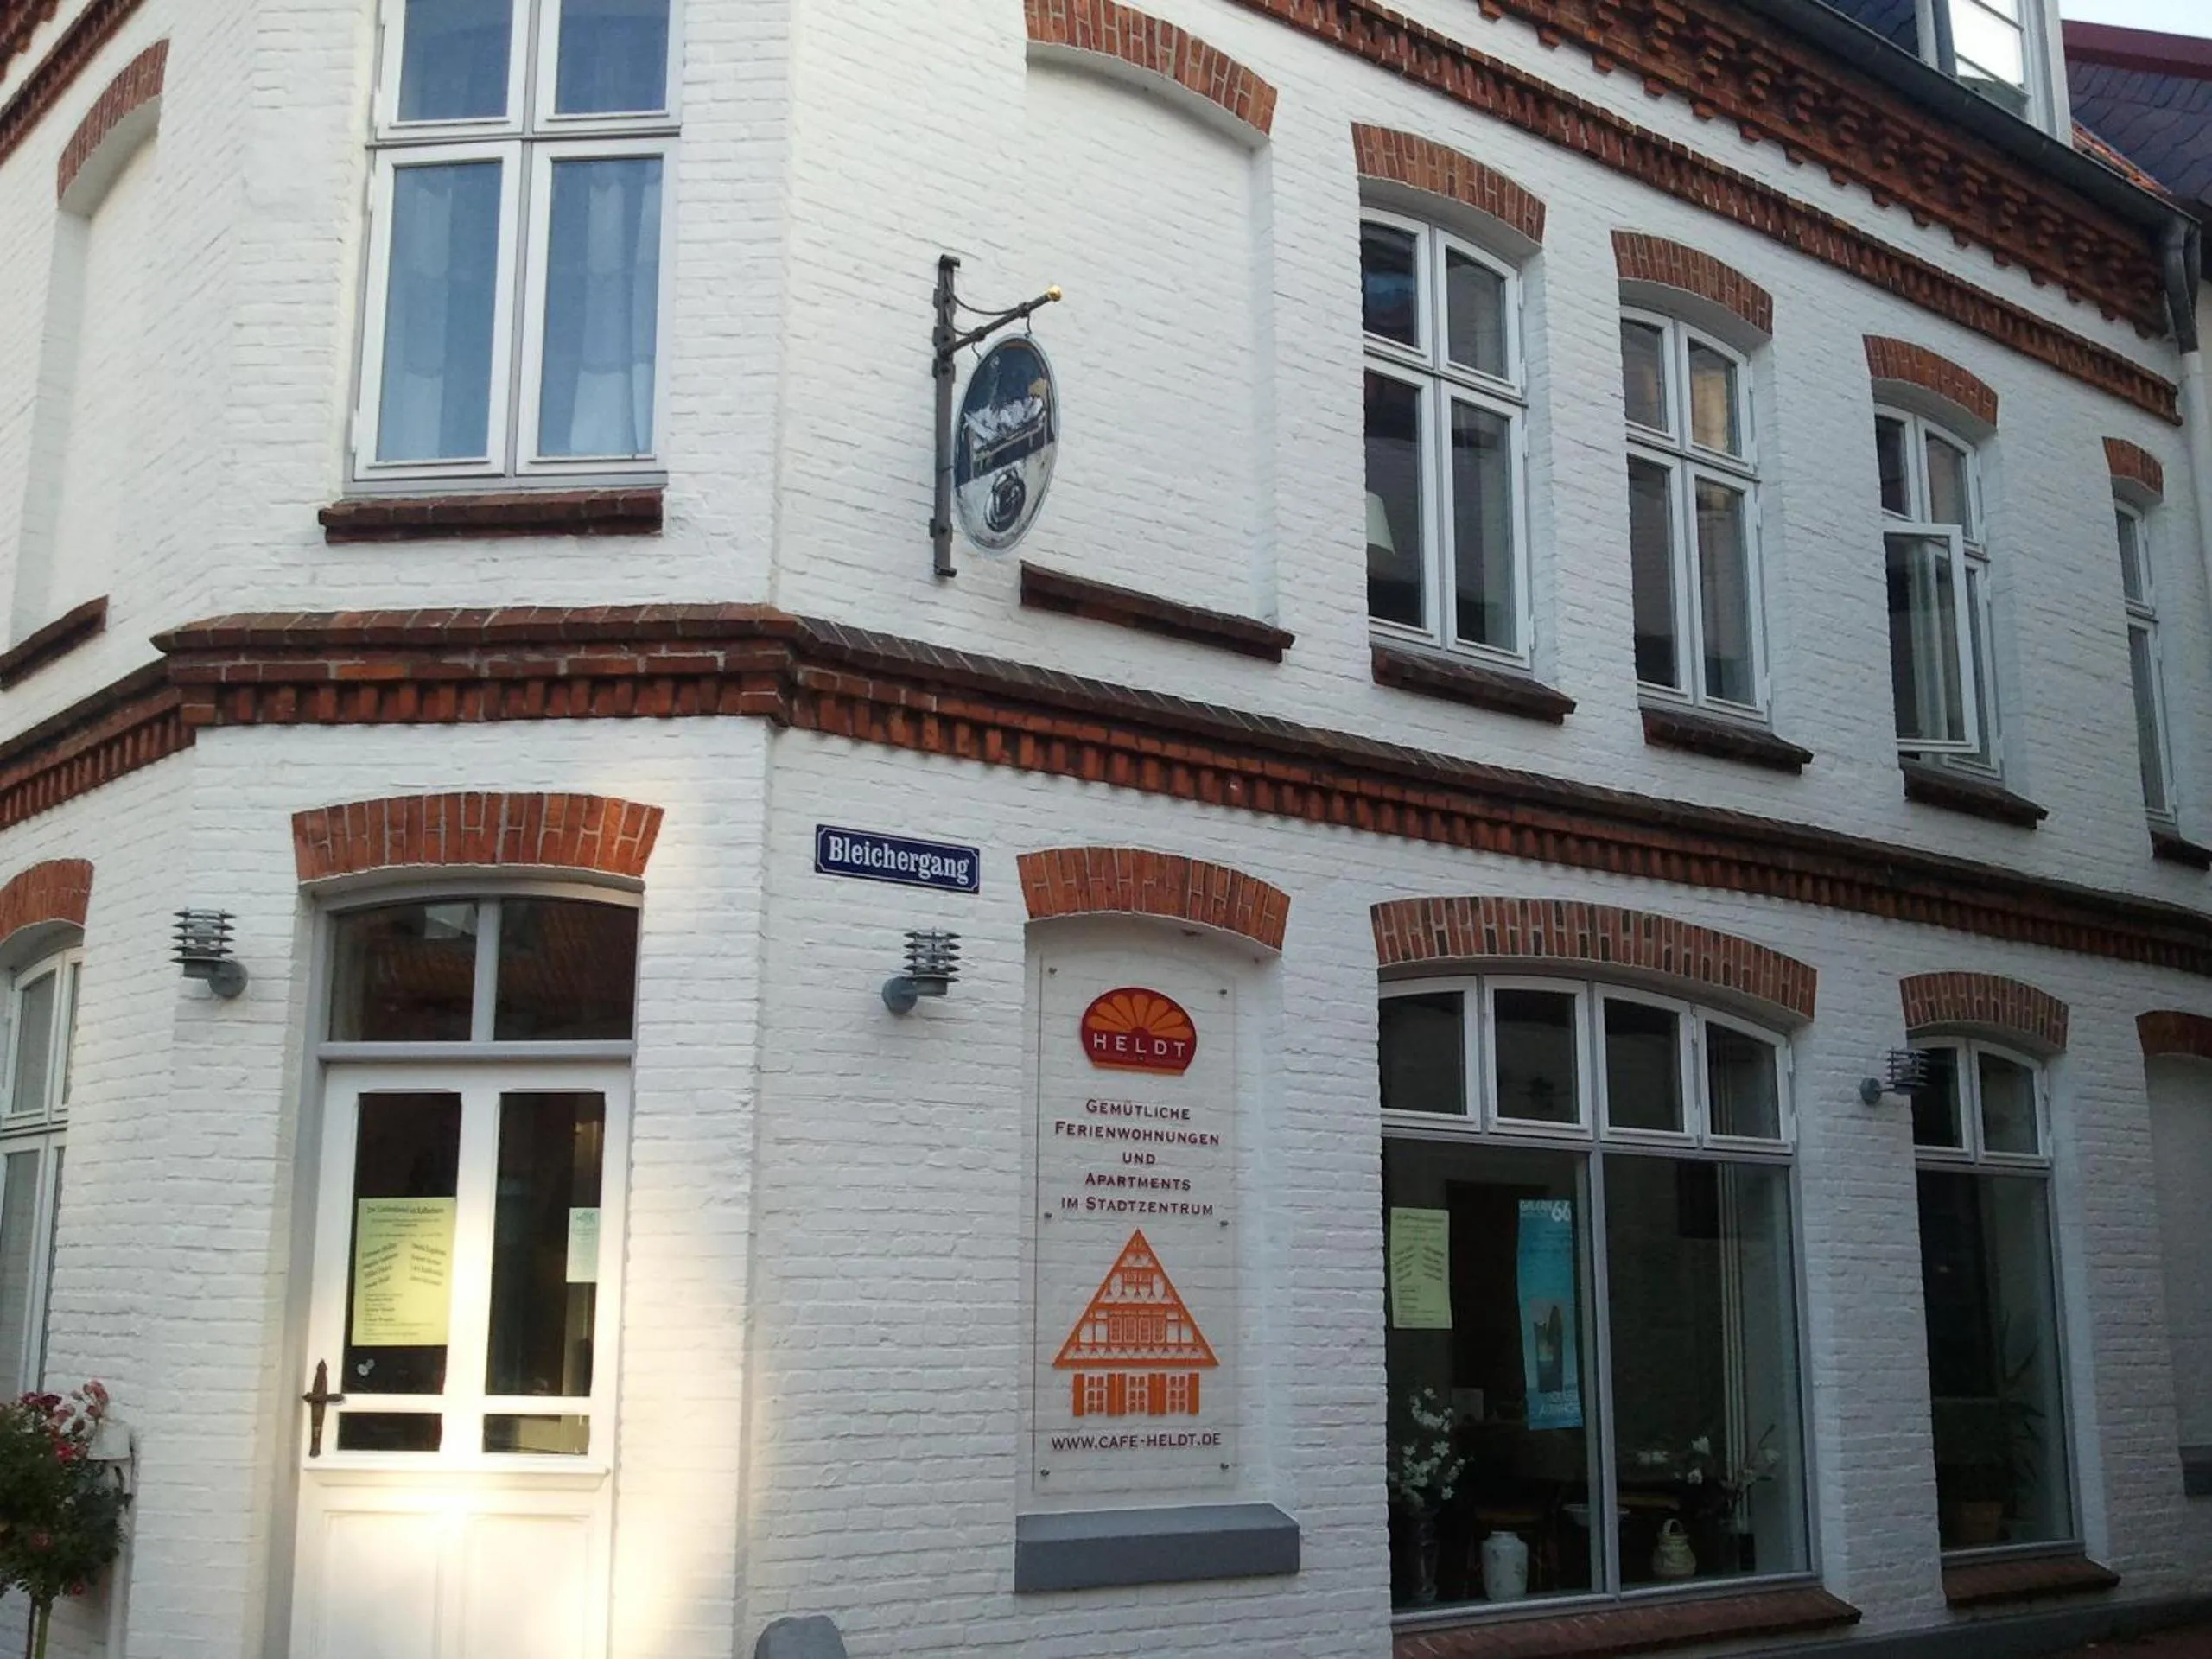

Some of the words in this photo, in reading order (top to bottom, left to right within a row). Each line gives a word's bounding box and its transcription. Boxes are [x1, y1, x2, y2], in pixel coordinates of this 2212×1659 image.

[828, 835, 969, 885] Bleichergang
[1093, 1033, 1186, 1058] HELDT
[1085, 1098, 1192, 1120] GEMÜTLICHE
[1054, 1121, 1220, 1146] FERIENWOHNUNGEN
[1122, 1152, 1156, 1165] UND
[1084, 1173, 1192, 1191] APARTMENTS
[1061, 1197, 1079, 1210] IM
[1085, 1196, 1213, 1216] STADTZENTRUM
[1051, 1432, 1223, 1450] WWW.CAFE-HELDT.DE
